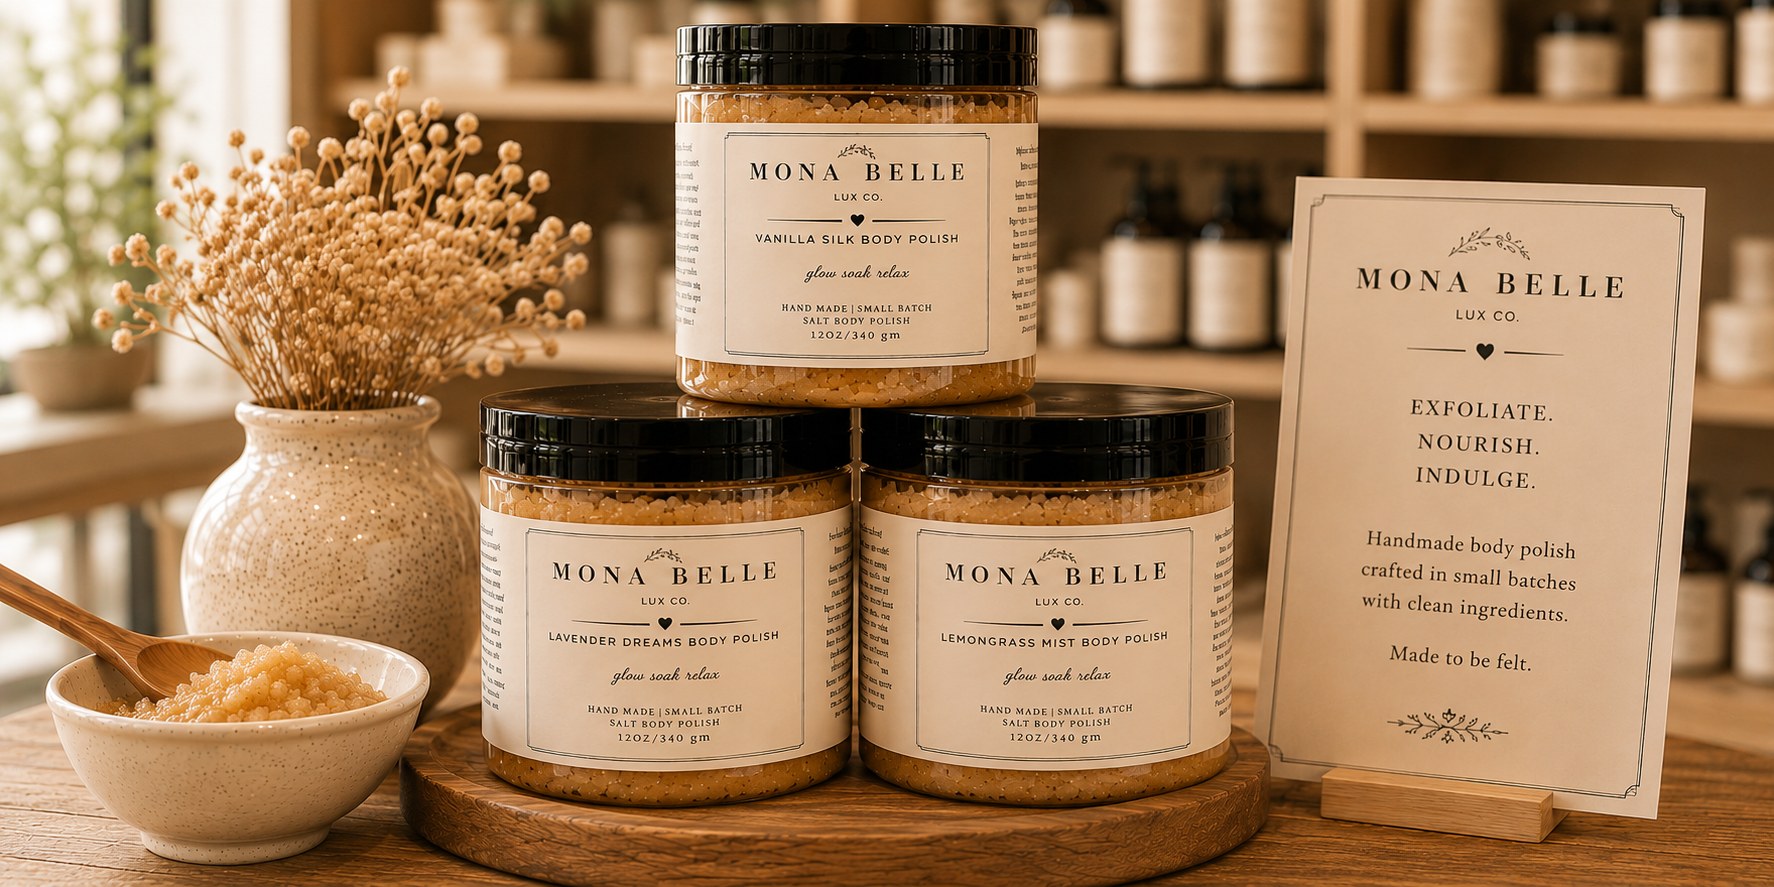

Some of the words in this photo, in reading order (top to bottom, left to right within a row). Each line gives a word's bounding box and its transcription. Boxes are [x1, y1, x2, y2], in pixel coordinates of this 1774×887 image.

[749, 162, 840, 182] MONA
[864, 162, 965, 182] BELLE
[833, 192, 858, 202] LUX
[862, 192, 883, 202] CO.
[755, 233, 816, 245] VANILLA
[821, 234, 855, 245] SILK
[861, 234, 903, 245] BODY
[908, 233, 959, 245] POLISH
[803, 264, 838, 284] glow
[840, 264, 872, 279] soak
[876, 264, 910, 279] relax
[1356, 267, 1469, 293] MONA
[1495, 272, 1624, 299] BELLE
[781, 303, 813, 313] HAND
[815, 304, 848, 314] MADE
[857, 304, 894, 314] SMALL
[897, 303, 932, 313] BATCH
[1455, 309, 1486, 321] LUX
[1492, 310, 1520, 323] CO.
[802, 316, 831, 326] SALT
[833, 316, 865, 326] BODY
[869, 316, 910, 326] POLISH
[880, 331, 901, 343] gm
[1410, 398, 1553, 422] EXFOLIATE.
[1418, 433, 1539, 456] NOURISH.
[1415, 466, 1536, 489] INDULGE.
[1367, 530, 1465, 552] Handmade
[1470, 536, 1515, 560] body
[1519, 541, 1576, 562] polish
[552, 561, 647, 586] MONA
[671, 560, 777, 586] BELLE
[945, 562, 1040, 586] MONA
[1065, 561, 1167, 586] BELLE
[1361, 561, 1424, 581] crafted
[1429, 565, 1448, 583] in
[1453, 568, 1501, 586] small
[1508, 570, 1577, 592] batches
[641, 597, 665, 606] LUX
[669, 596, 691, 606] CO.
[1035, 597, 1059, 607] LUX
[1063, 597, 1084, 607] CO.
[1362, 593, 1401, 610] with
[1407, 594, 1454, 614] clean
[1459, 599, 1568, 622] ingredients.
[548, 631, 617, 647] LAVENDER
[622, 637, 682, 648] DREAMS
[688, 635, 728, 647] BODY
[732, 630, 779, 644] POLISH
[941, 632, 1036, 648] LEMONGRASS
[1041, 638, 1076, 648] MIST
[1081, 636, 1120, 647] BODY
[1124, 630, 1168, 644] POLISH
[1389, 644, 1440, 664] Made
[1445, 652, 1464, 666] to
[1470, 650, 1491, 669] be
[1496, 652, 1532, 672] felt.
[610, 666, 646, 686] glow
[649, 668, 681, 682] soak
[684, 666, 721, 681] relax
[1002, 666, 1038, 686] glow
[1041, 667, 1073, 682] soak
[1075, 666, 1112, 682] relax
[587, 704, 620, 716] HAND
[622, 707, 656, 717] MADE
[664, 706, 703, 717] SMALL
[707, 704, 743, 715] BATCH
[980, 704, 1012, 716] HAND
[1015, 707, 1049, 717] MADE
[1057, 706, 1095, 717] SMALL
[1097, 704, 1133, 715] BATCH
[609, 718, 639, 729] SALT
[641, 719, 674, 729] BODY
[677, 718, 720, 729] POLISH
[1002, 718, 1032, 728] SALT
[1033, 719, 1066, 729] BODY
[1069, 717, 1111, 728] POLISH
[688, 732, 710, 745] gm
[1080, 732, 1102, 745] gm
